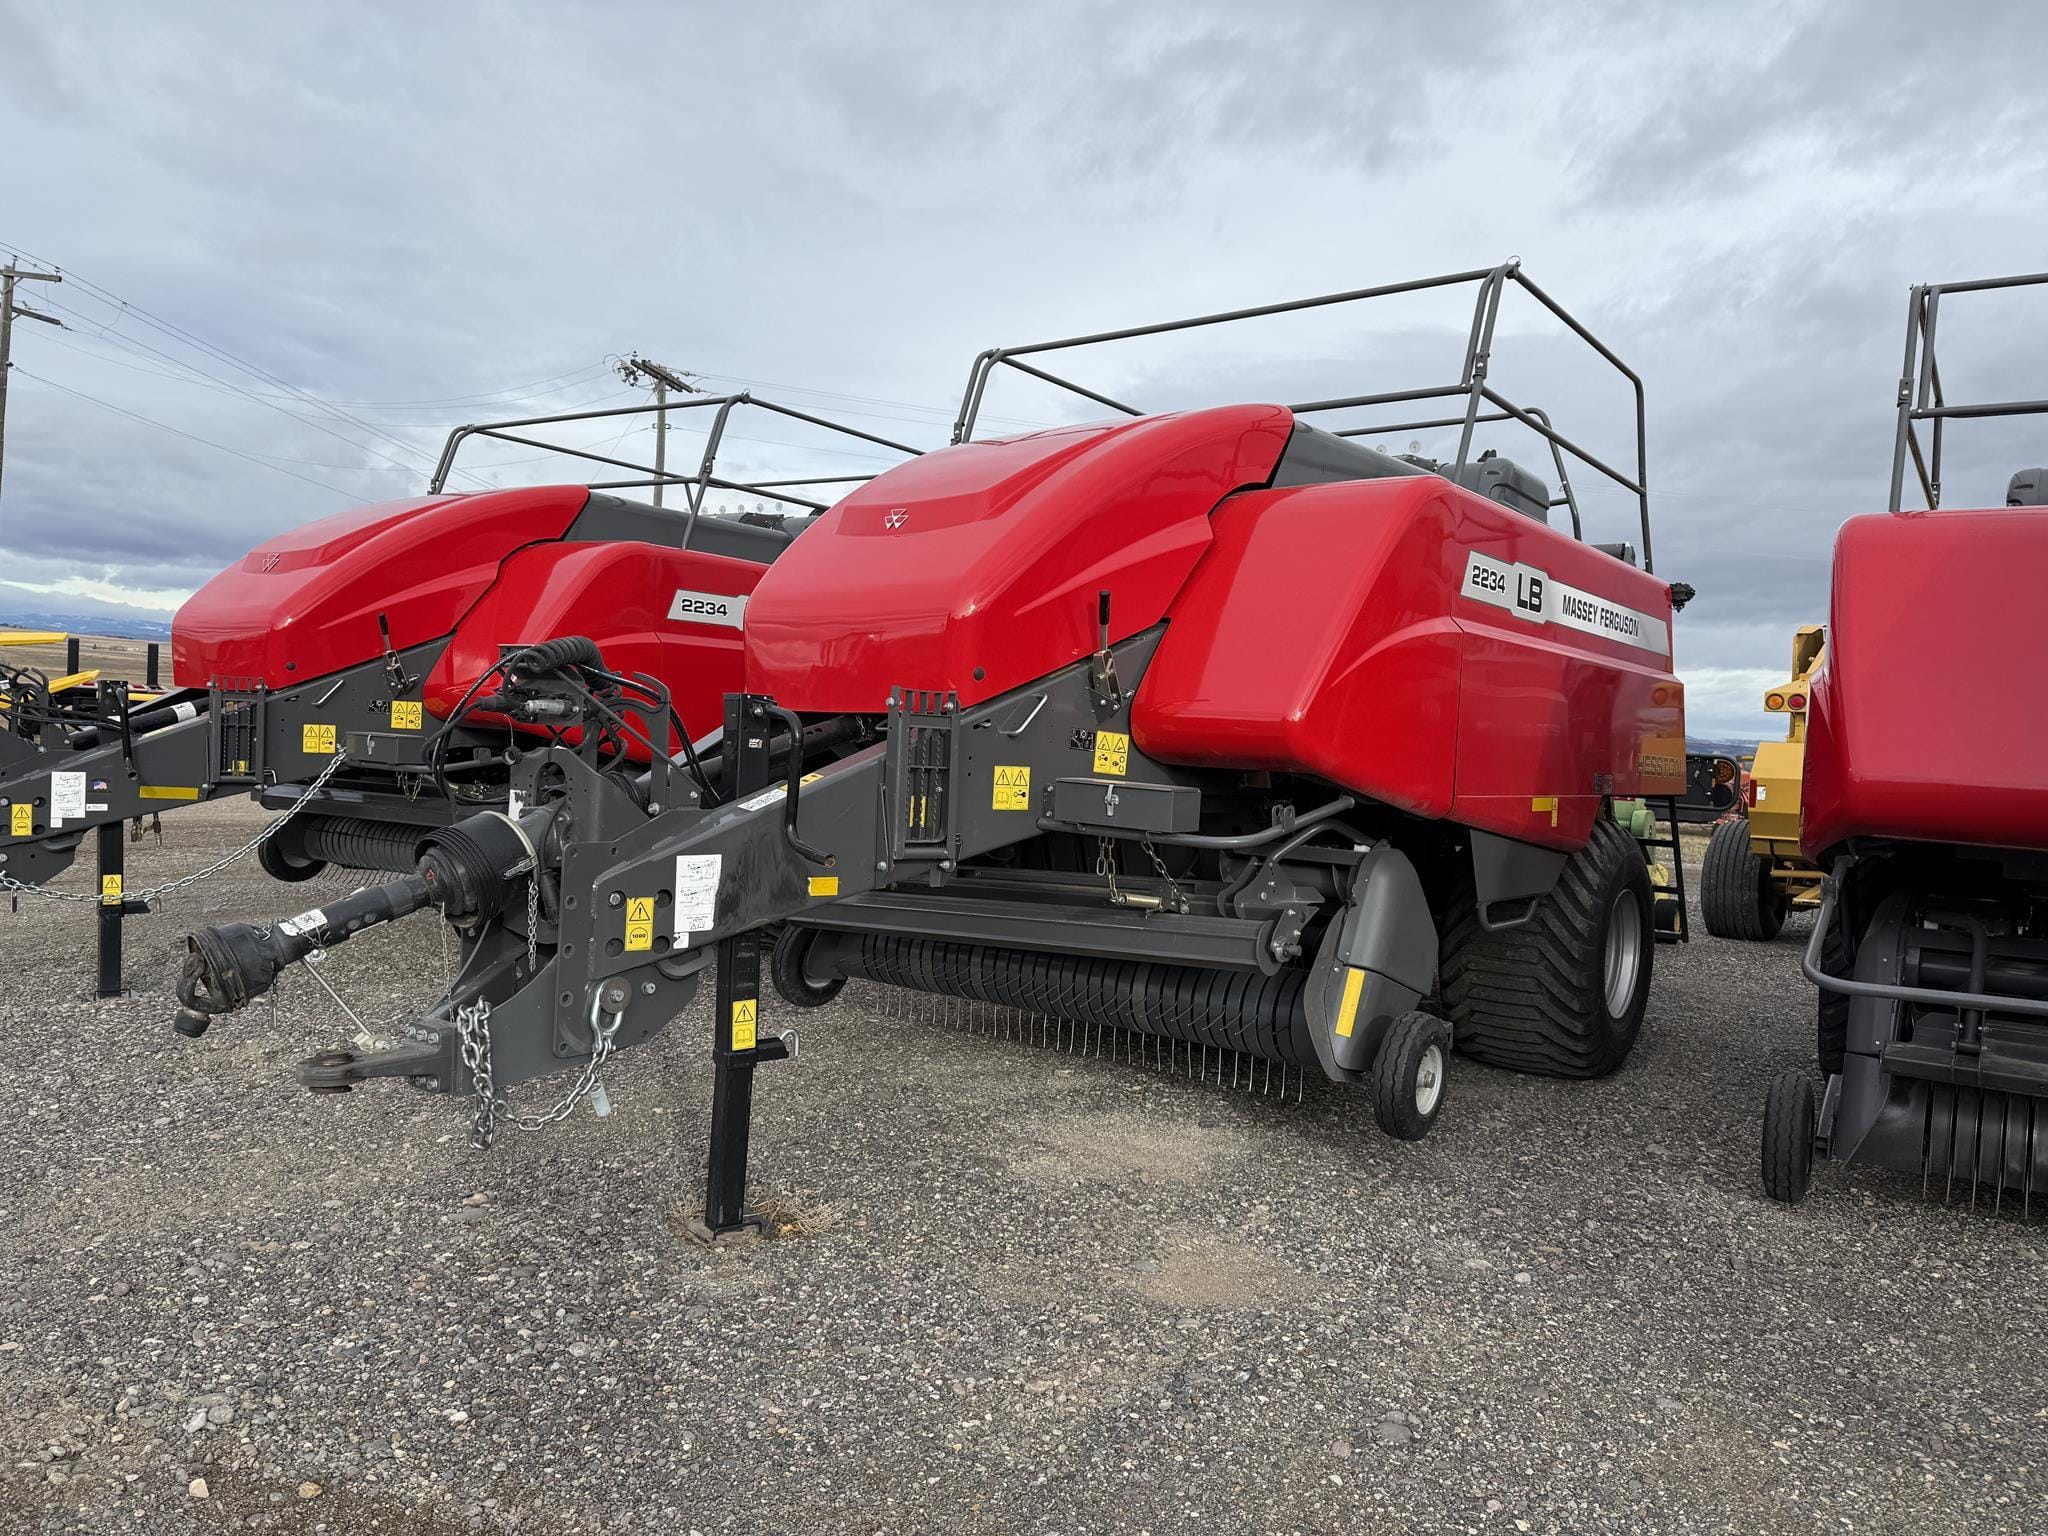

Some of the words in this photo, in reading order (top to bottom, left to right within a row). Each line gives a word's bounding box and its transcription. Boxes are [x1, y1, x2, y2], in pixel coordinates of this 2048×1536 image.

[681, 599, 728, 616] 2234
[1472, 565, 1506, 594] 2234
[1517, 573, 1543, 613] LB
[1562, 594, 1598, 624] MASSEY
[1600, 607, 1640, 637] FERGUSON
